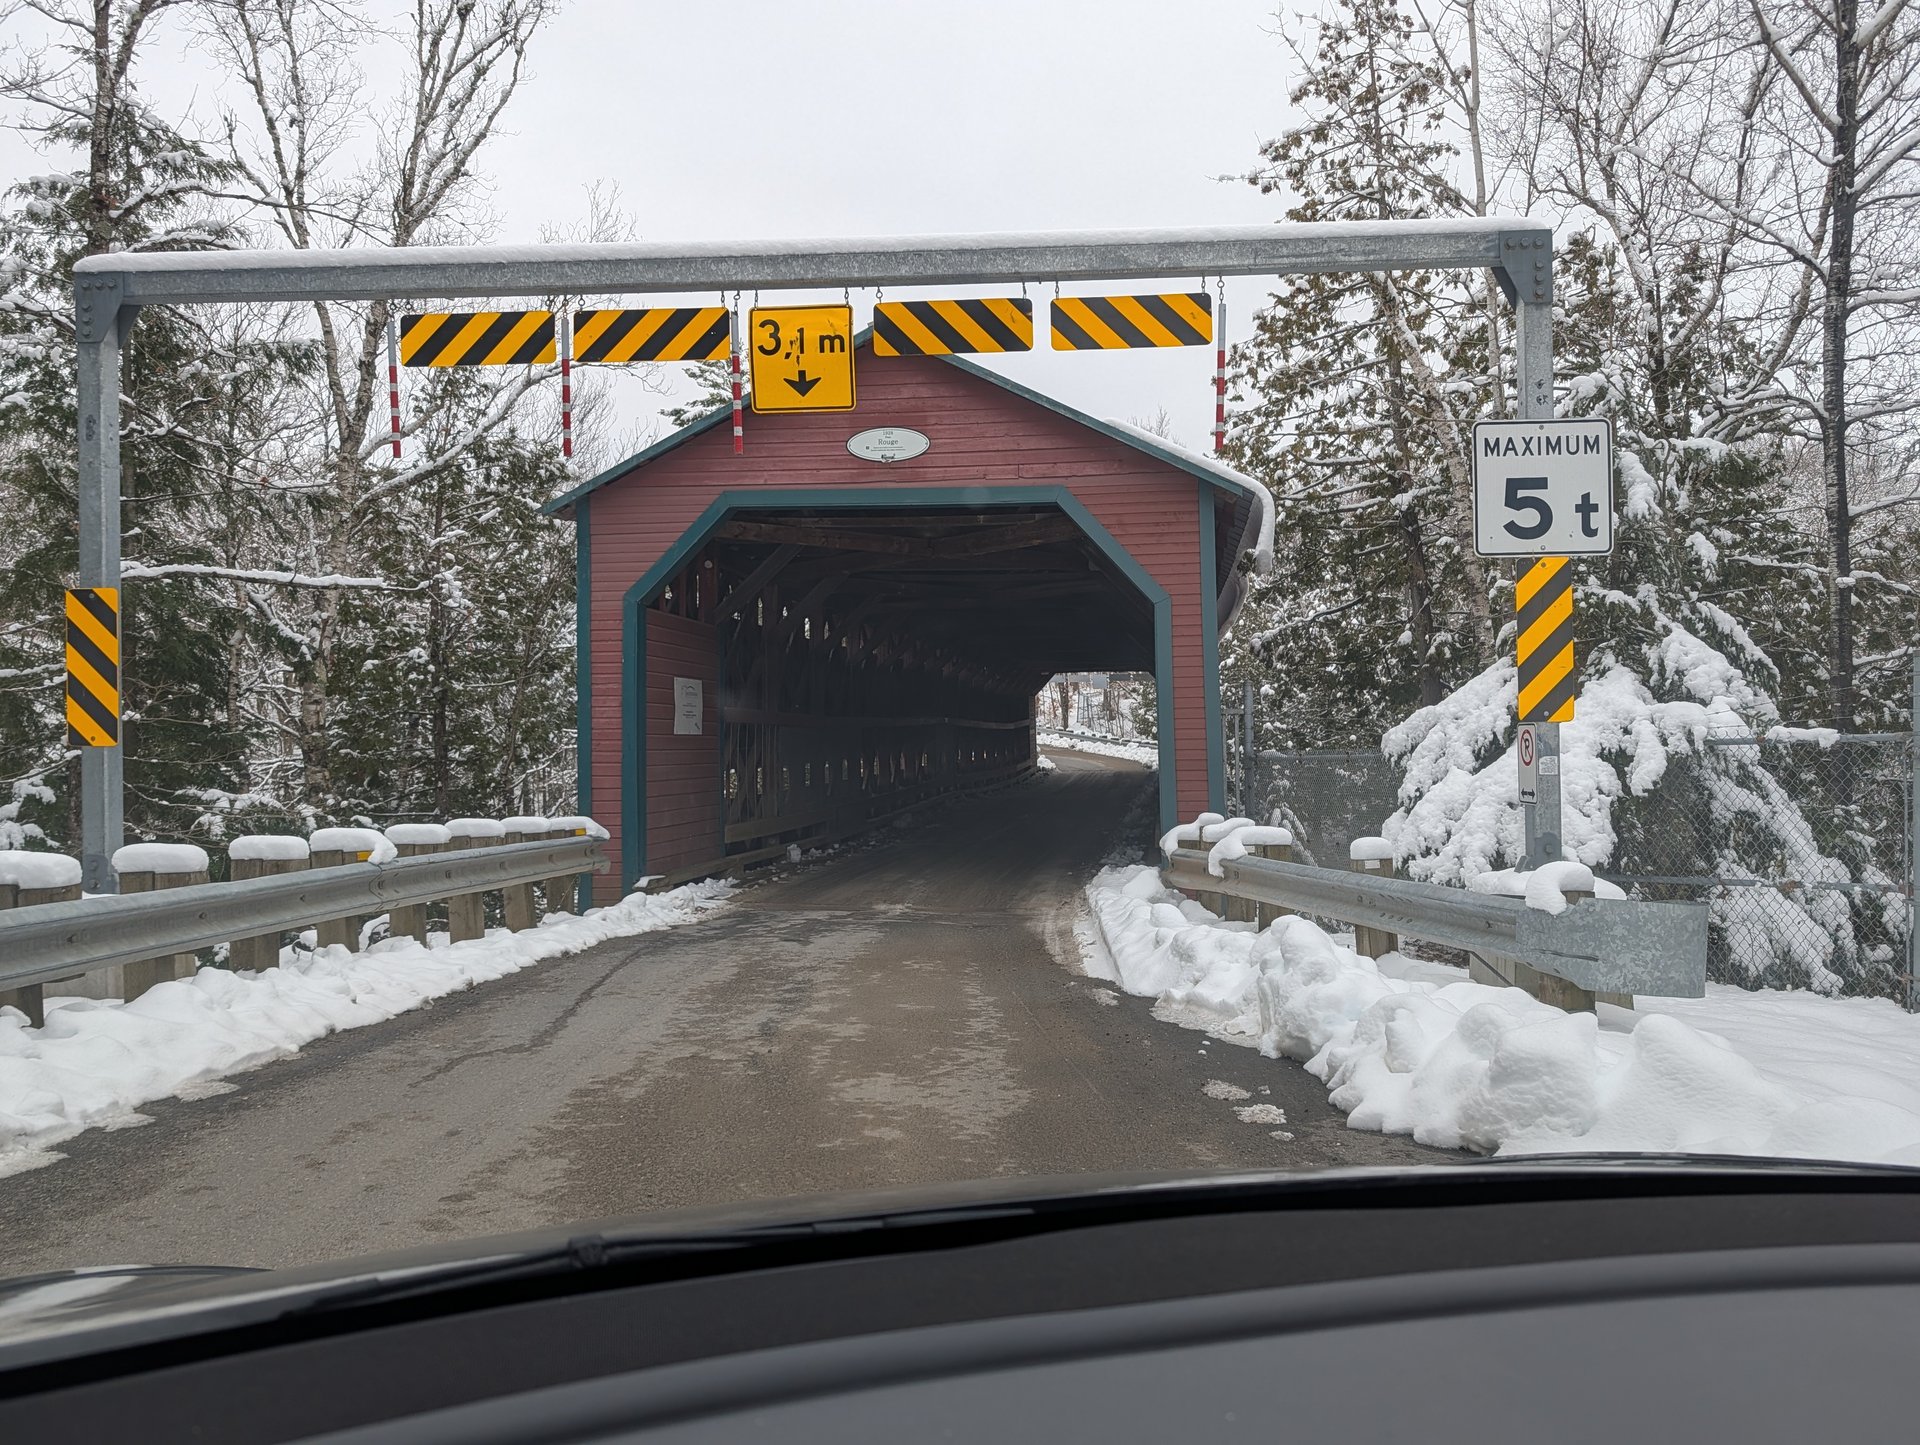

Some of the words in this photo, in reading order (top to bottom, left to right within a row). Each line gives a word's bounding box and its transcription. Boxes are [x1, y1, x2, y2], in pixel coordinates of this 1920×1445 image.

[757, 319, 805, 360] 3,1
[818, 334, 845, 353] m
[1484, 434, 1600, 457] MAXIMUM
[1502, 477, 1553, 540] 5
[1574, 491, 1599, 538] t
